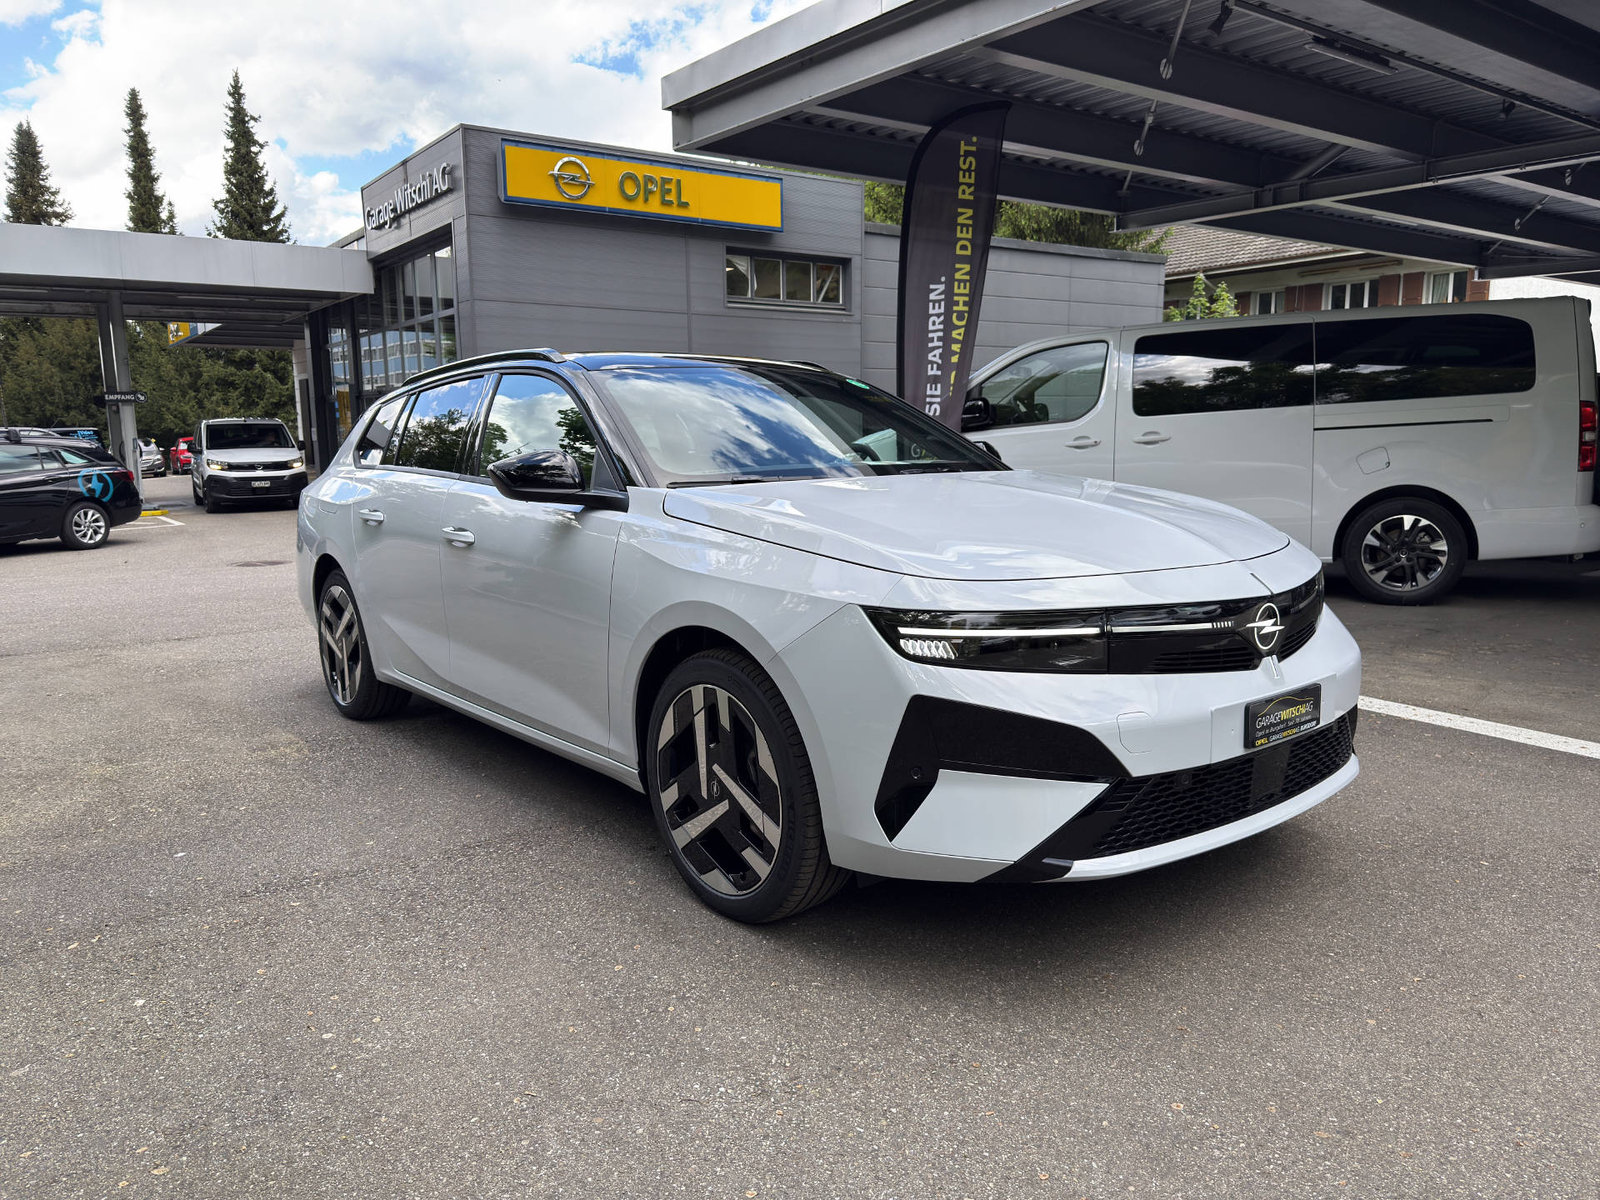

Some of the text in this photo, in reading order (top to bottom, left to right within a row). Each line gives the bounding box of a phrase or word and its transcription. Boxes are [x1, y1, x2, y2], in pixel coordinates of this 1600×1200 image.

[365, 163, 449, 230] Garage Witschi AG
[619, 171, 691, 208] OPEL
[958, 136, 978, 200] REST.
[955, 208, 974, 256] DEN
[924, 276, 946, 417] SIE FAHREN.
